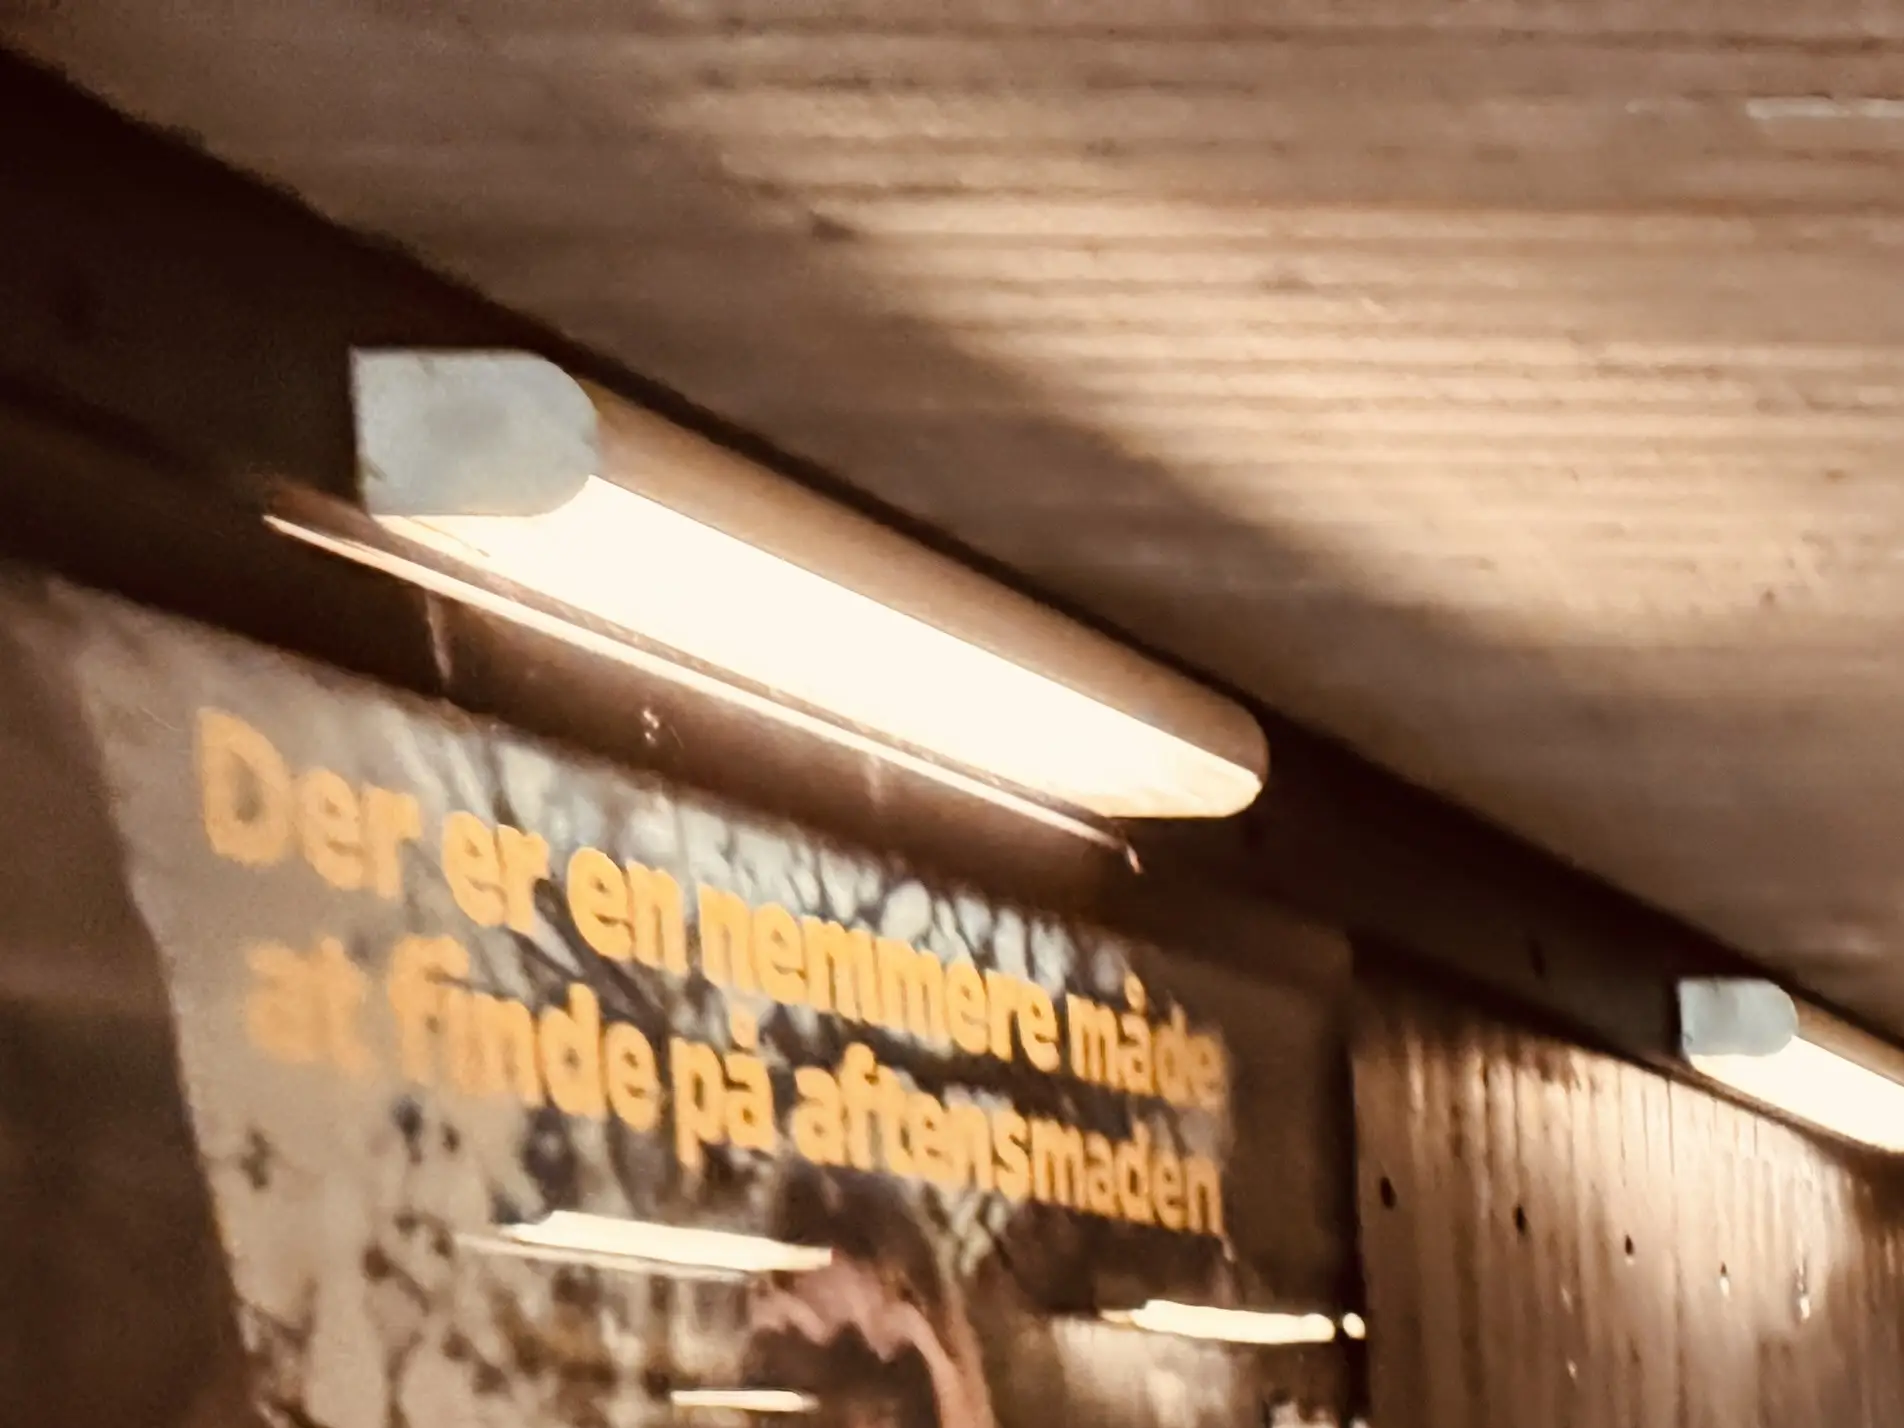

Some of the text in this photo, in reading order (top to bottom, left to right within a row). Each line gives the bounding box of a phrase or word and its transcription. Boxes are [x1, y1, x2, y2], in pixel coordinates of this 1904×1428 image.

[196, 707, 1228, 1108] Der er en nemmere måde
[246, 934, 1226, 1237] at finde på aftensmaden
